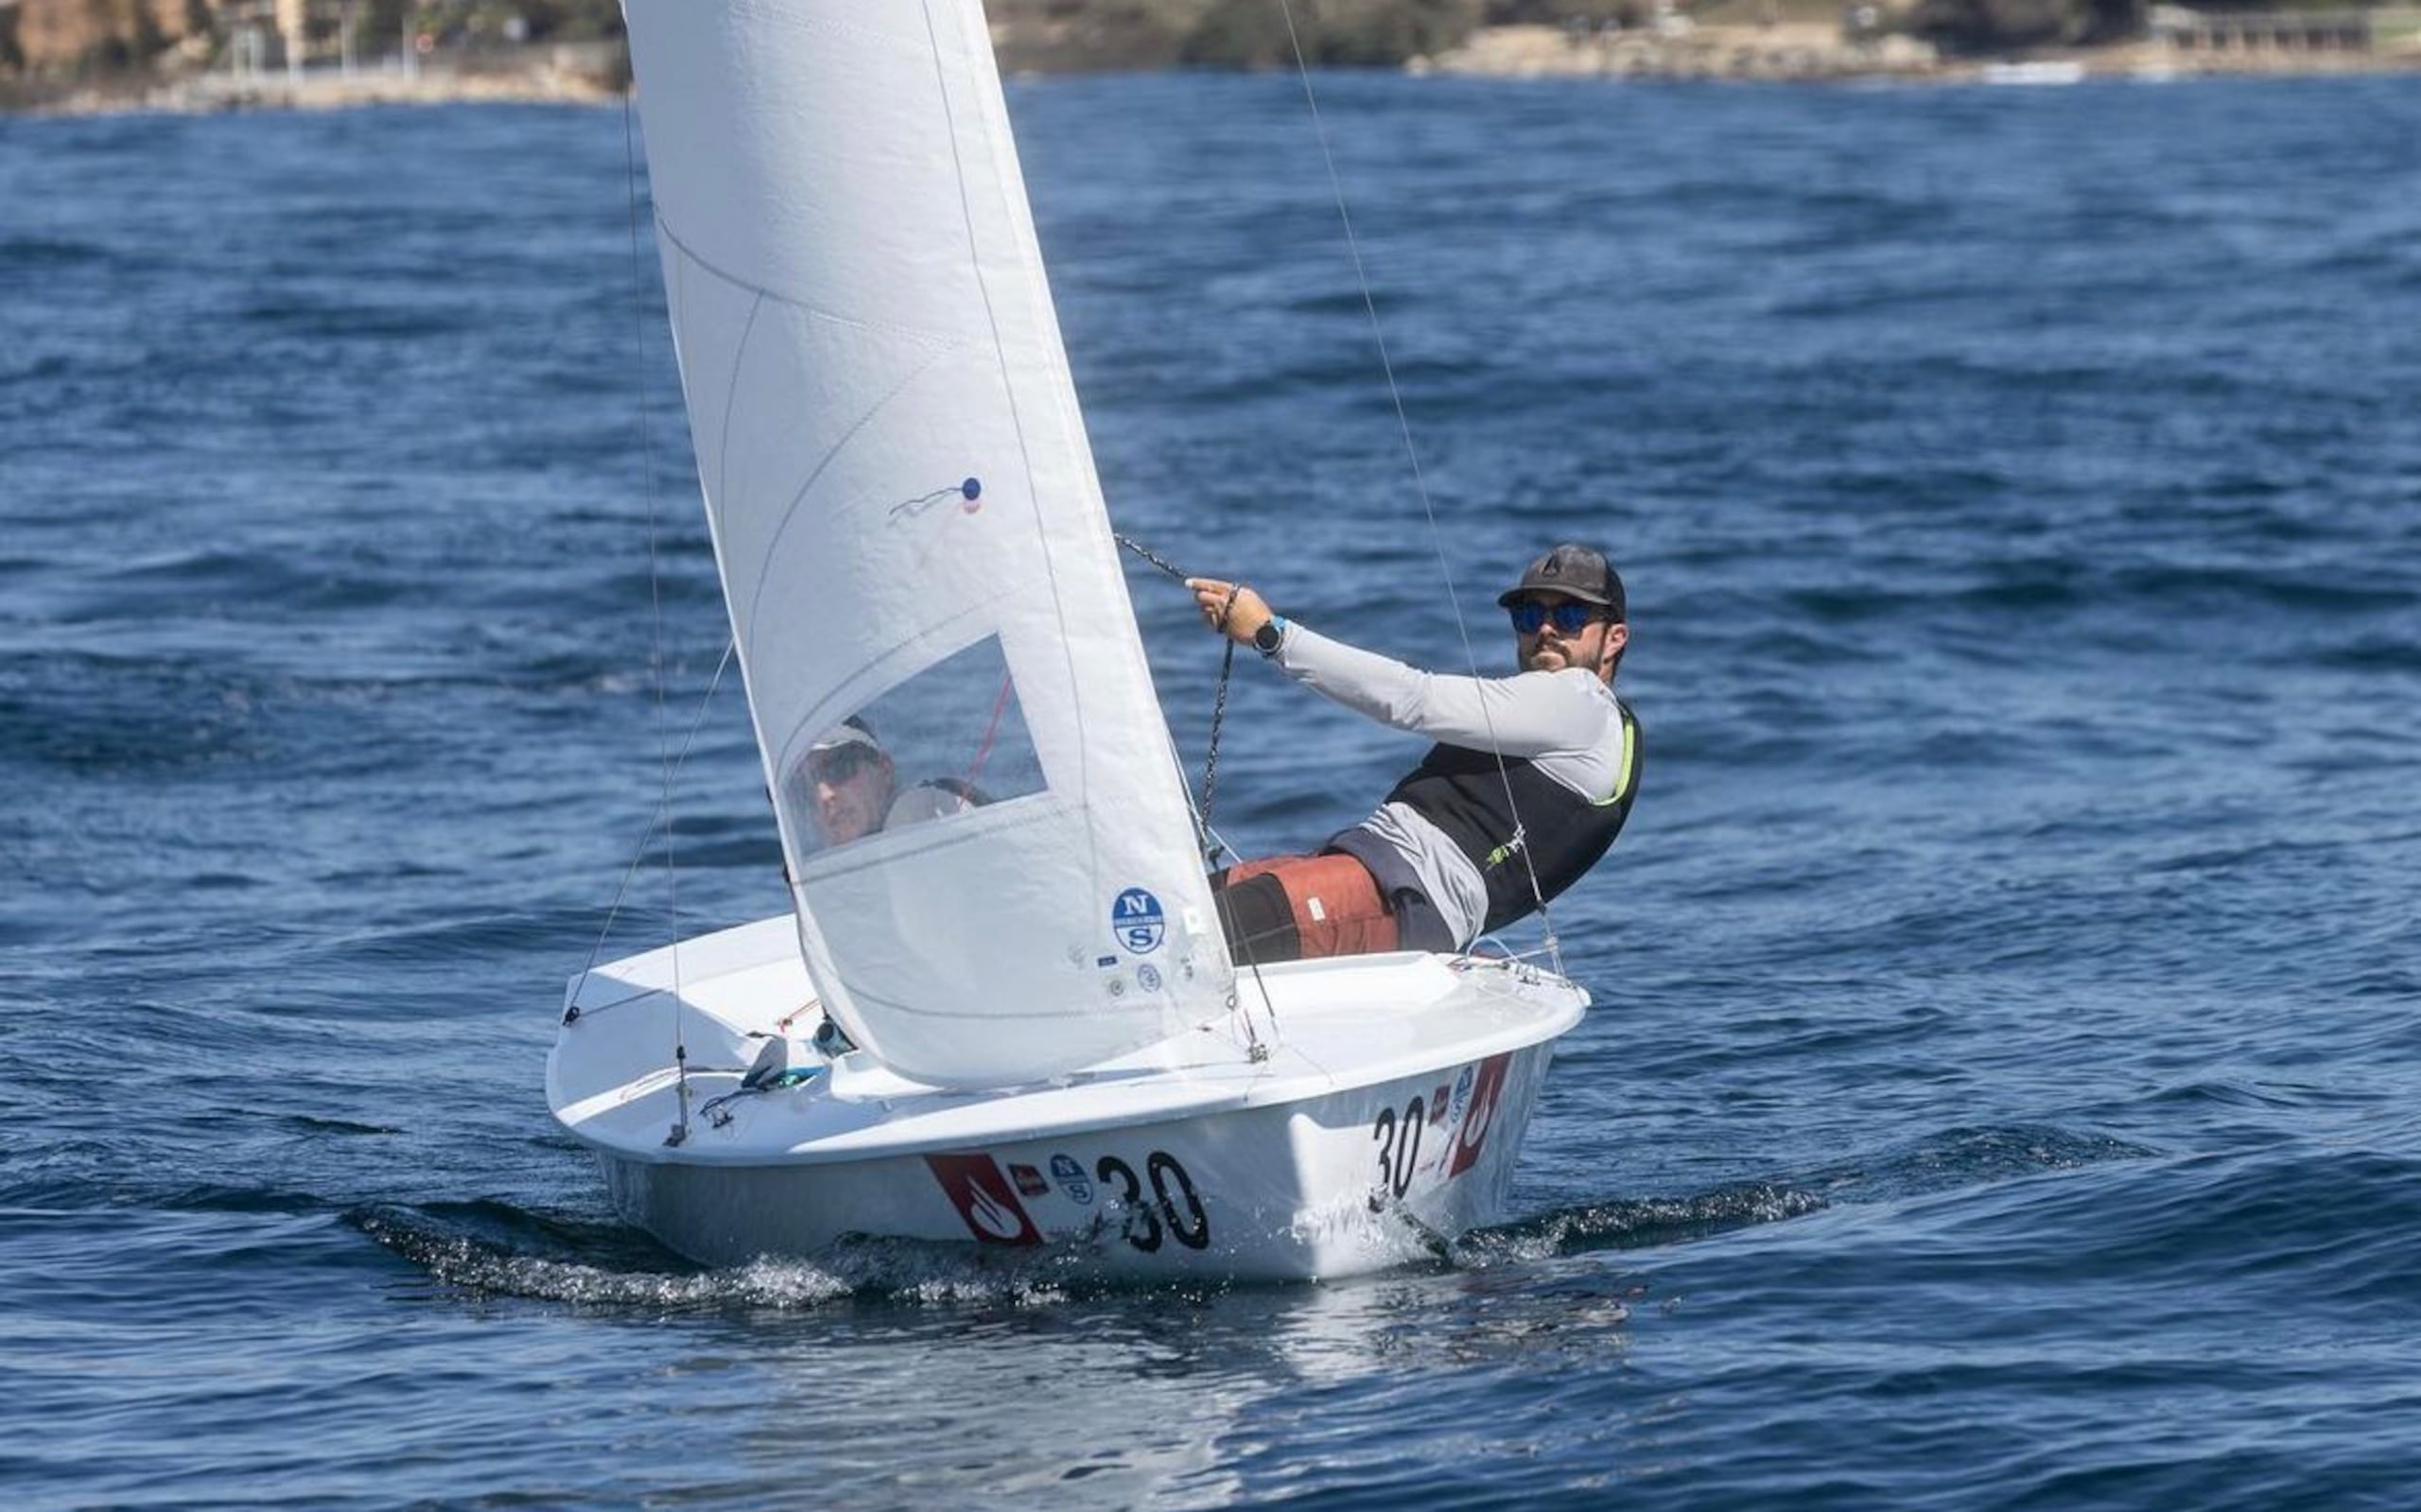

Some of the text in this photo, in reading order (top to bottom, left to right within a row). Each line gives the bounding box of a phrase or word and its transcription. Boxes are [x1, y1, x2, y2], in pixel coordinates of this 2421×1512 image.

[1122, 895, 1148, 915] N
[1128, 928, 1154, 947] S
[1368, 1095, 1425, 1214] 30
[1096, 1150, 1210, 1254] 30
